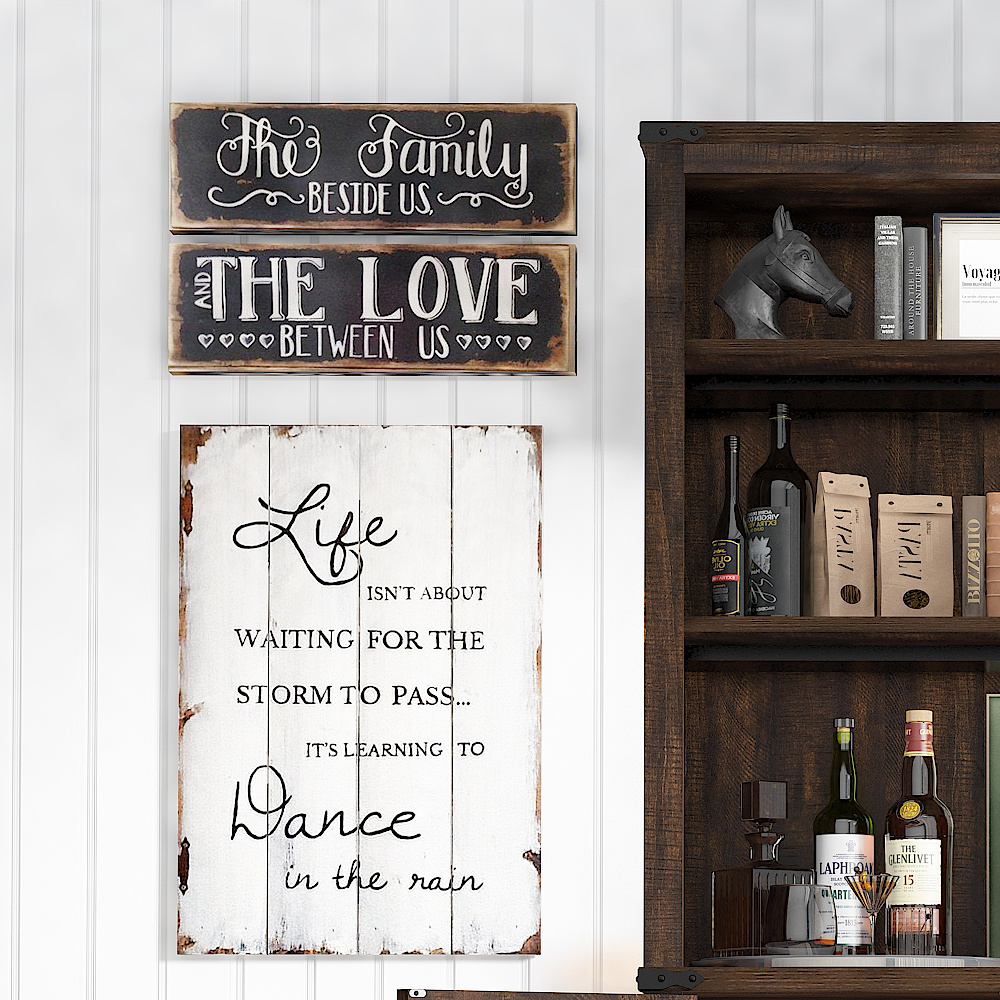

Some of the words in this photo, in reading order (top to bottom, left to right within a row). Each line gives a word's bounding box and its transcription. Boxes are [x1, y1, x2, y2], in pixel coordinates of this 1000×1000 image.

[217, 112, 321, 178] The
[357, 112, 533, 198] Family
[308, 182, 391, 215] BESIDE
[193, 272, 212, 309] AND
[196, 256, 325, 321] THE
[359, 255, 540, 324] LOVE
[279, 324, 395, 359] BETWEEN
[418, 324, 450, 359] US
[233, 483, 398, 586] Life
[367, 586, 415, 601] ISN'T
[421, 586, 487, 601] ABOUT
[235, 628, 354, 650] WAITING
[368, 630, 423, 650] FOR
[429, 630, 485, 650] THE
[237, 685, 332, 705] STORM
[341, 685, 381, 705] TO
[392, 685, 471, 706] PASS...
[306, 743, 338, 757] IT'S
[344, 742, 442, 757] LEARNING
[458, 742, 485, 757] TO
[231, 765, 421, 840] Dance
[889, 854, 934, 865] GLENLIVET
[901, 845, 916, 853] THE
[285, 865, 318, 890] in
[332, 859, 388, 890] the
[409, 866, 484, 891] rain
[903, 874, 914, 885] 15
